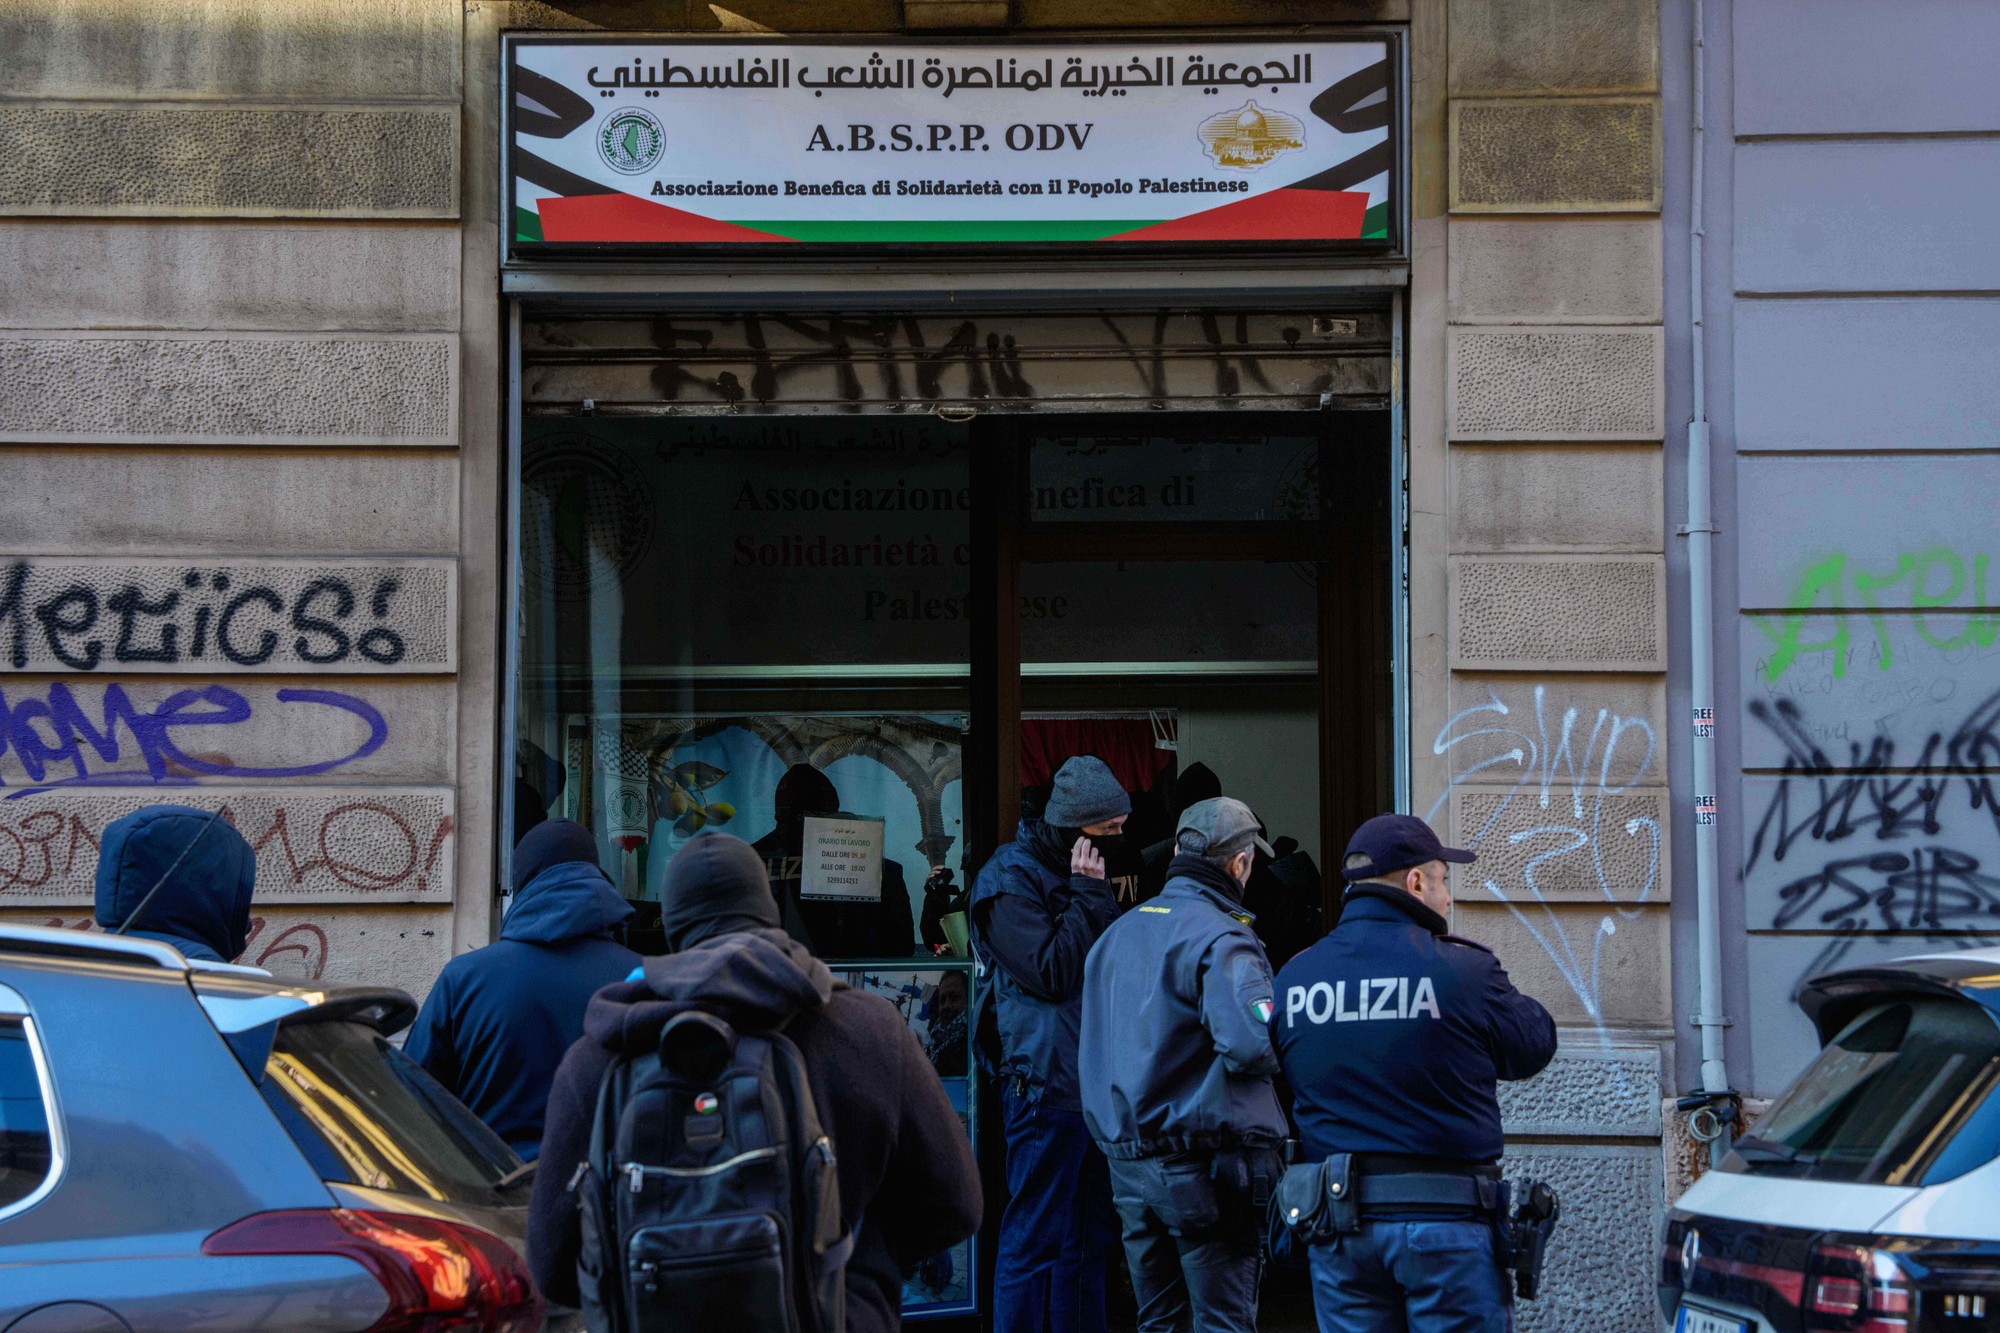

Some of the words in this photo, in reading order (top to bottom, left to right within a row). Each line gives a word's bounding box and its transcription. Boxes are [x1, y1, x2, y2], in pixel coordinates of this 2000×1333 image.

[587, 57, 790, 98] الفلسطيني
[797, 52, 915, 98] الشعب
[922, 57, 1052, 98] لمناصرة
[1060, 56, 1174, 97] الخيرية
[1182, 54, 1312, 95] الجمعية
[805, 124, 990, 152] A.B.S.P.P.
[1005, 123, 1094, 152] ODV
[650, 180, 779, 197] Associazione
[783, 179, 867, 196] Benefica
[871, 179, 892, 196] di
[896, 179, 1004, 196] Solidarietà
[1008, 183, 1044, 196] con
[1048, 179, 1063, 195] il
[1067, 178, 1134, 199] Popolo
[1138, 177, 1250, 195] Palestinese
[732, 479, 971, 512] Associazione
[1159, 474, 1196, 507] di
[733, 534, 940, 567] Solidarietà
[818, 837, 839, 845] ORARIO
[848, 839, 871, 847] LAVORO
[821, 850, 838, 858] DALLE
[839, 851, 850, 859] ORE
[1286, 977, 1440, 1028] POLIZIA
